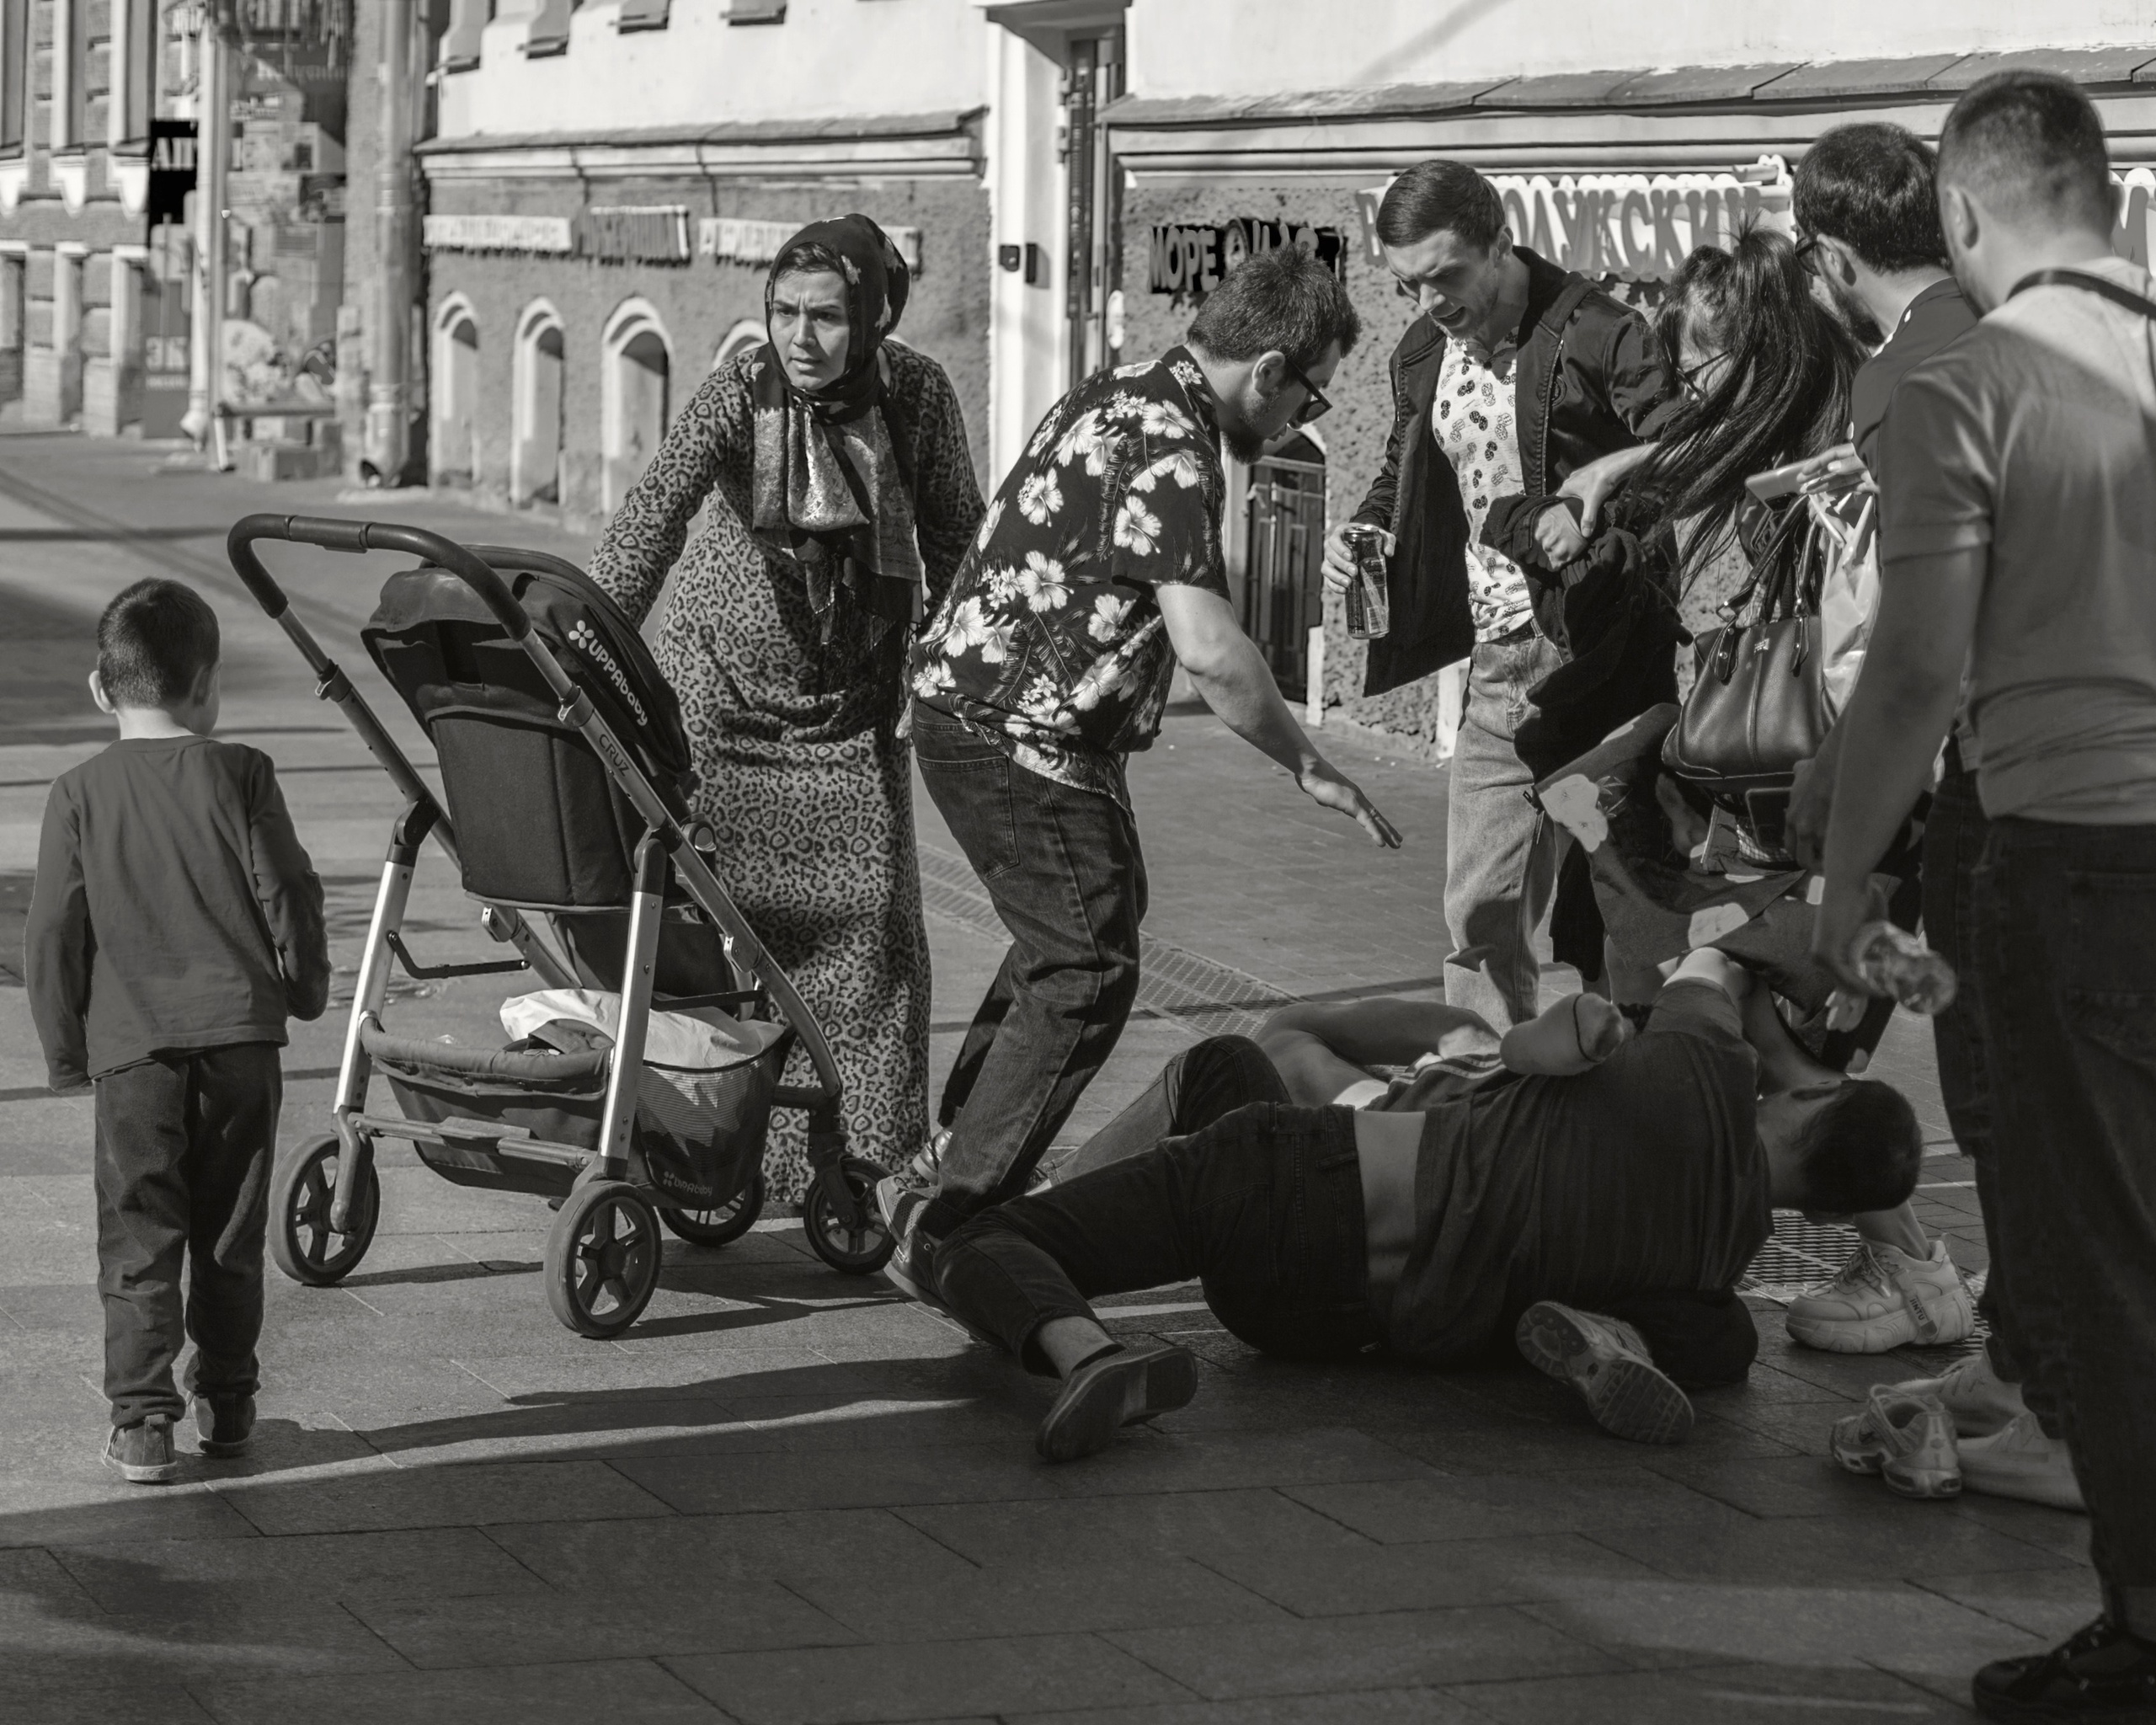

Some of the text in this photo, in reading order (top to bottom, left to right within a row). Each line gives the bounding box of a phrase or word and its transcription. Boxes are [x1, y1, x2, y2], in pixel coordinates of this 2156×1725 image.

[1147, 226, 1219, 293] МОРЕ
[589, 638, 648, 726] UPPAbaby
[599, 734, 630, 777] CRUZ
